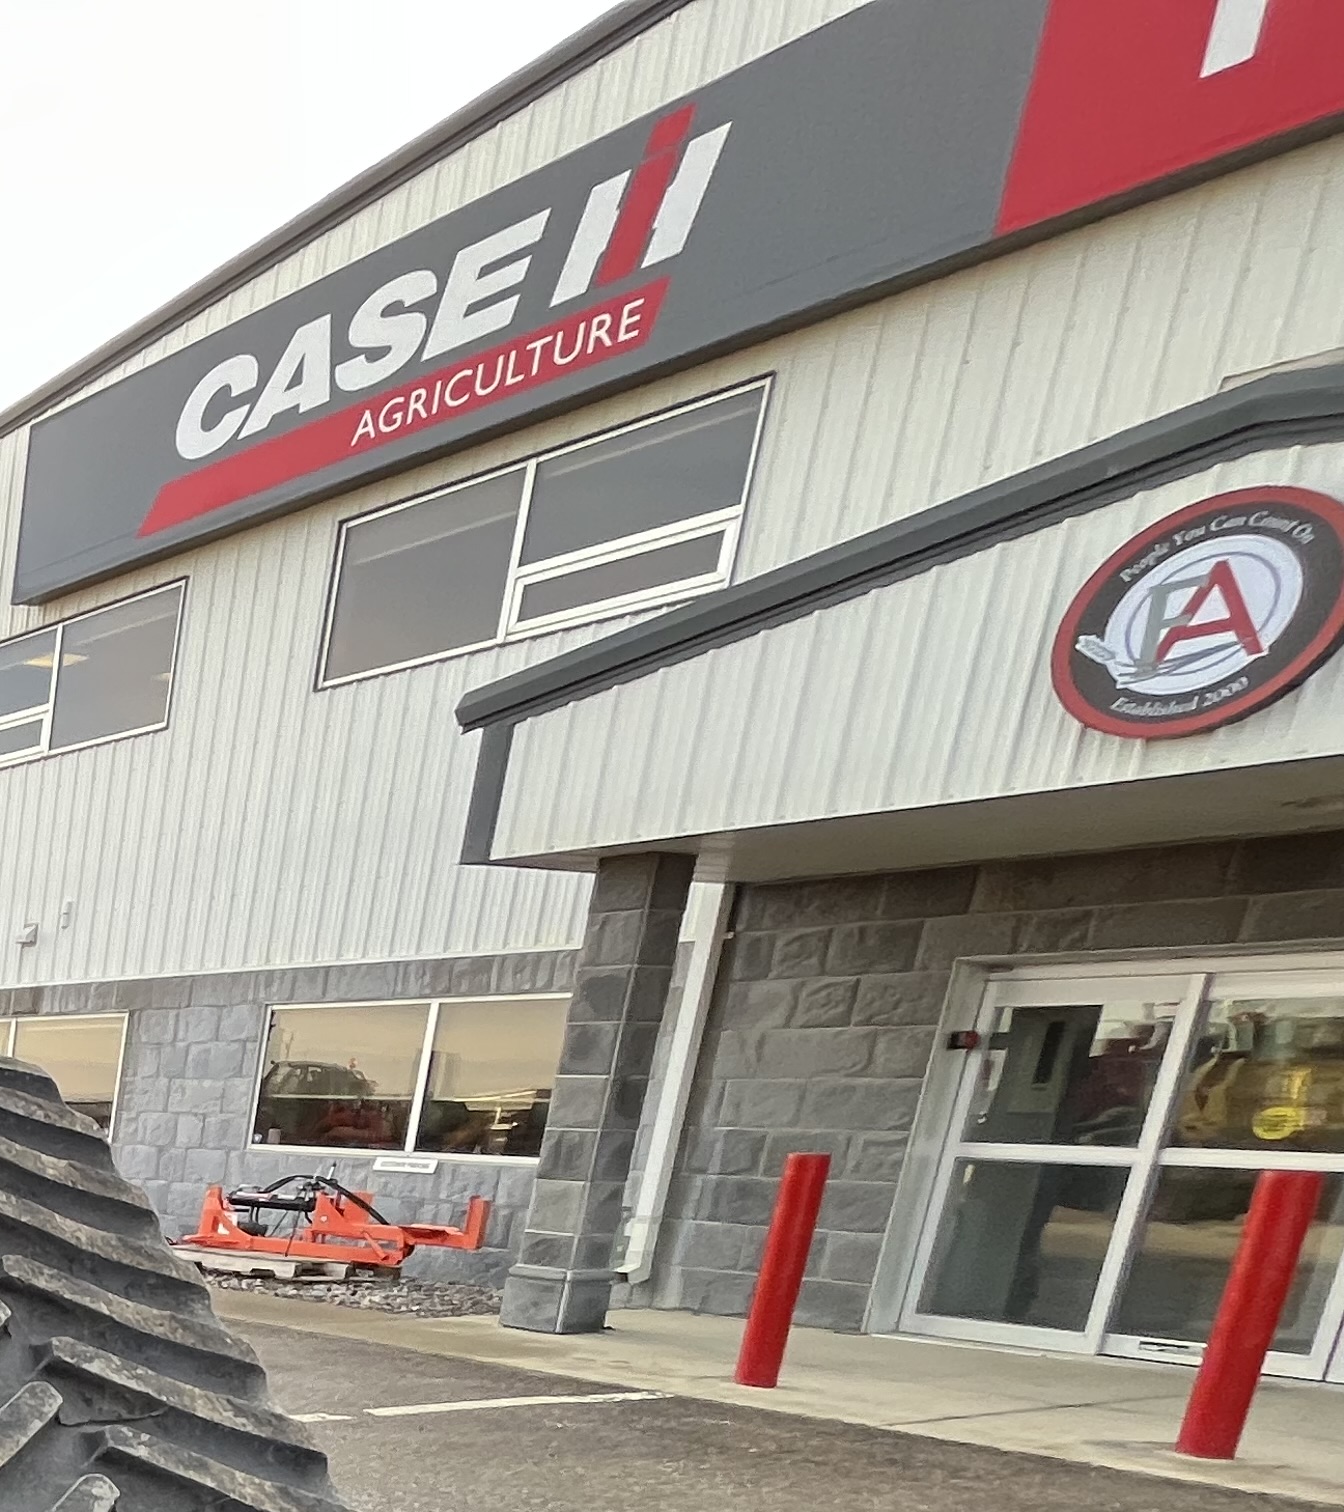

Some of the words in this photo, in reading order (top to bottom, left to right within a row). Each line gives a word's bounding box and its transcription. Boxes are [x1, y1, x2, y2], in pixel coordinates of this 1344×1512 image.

[175, 207, 552, 461] CASE
[350, 297, 646, 448] AGRICULTURE
[1119, 543, 1170, 582] People
[1172, 525, 1206, 546] You
[1210, 515, 1247, 532] Can
[1248, 510, 1298, 533] Count
[1291, 521, 1315, 545] On
[1110, 695, 1199, 717] Established
[1202, 676, 1249, 707] 2000
